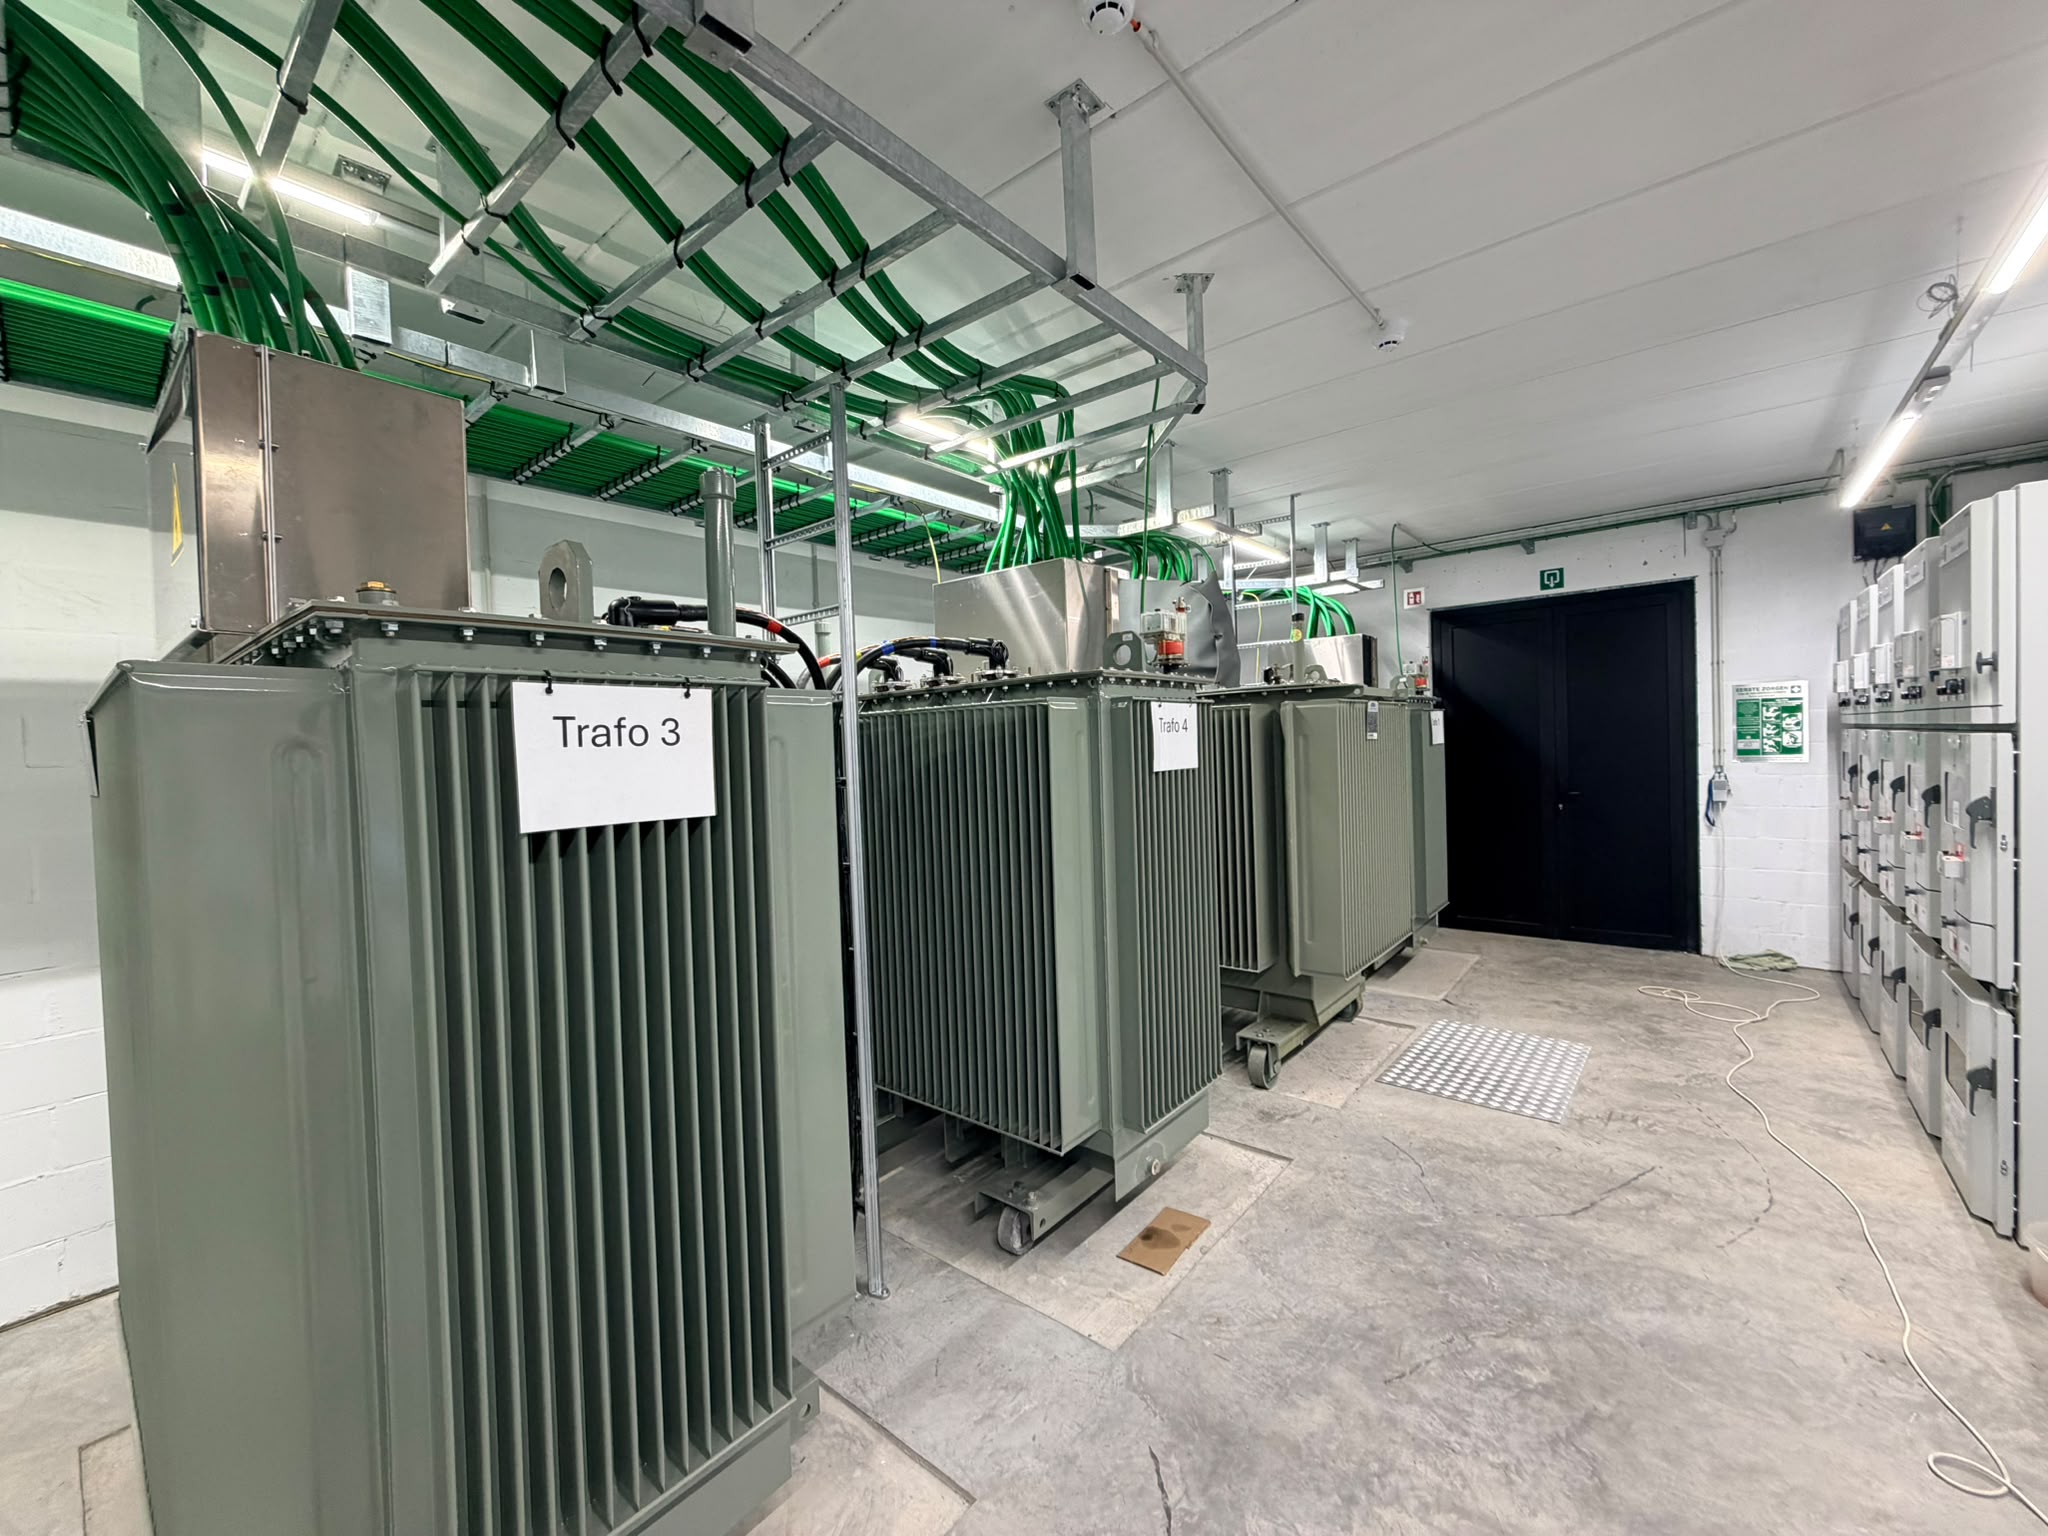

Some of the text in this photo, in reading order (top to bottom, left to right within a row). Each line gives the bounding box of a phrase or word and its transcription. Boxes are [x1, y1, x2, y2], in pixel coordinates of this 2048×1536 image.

[552, 715, 681, 748] Trafo 3
[1158, 717, 1188, 733] Trafo 4
